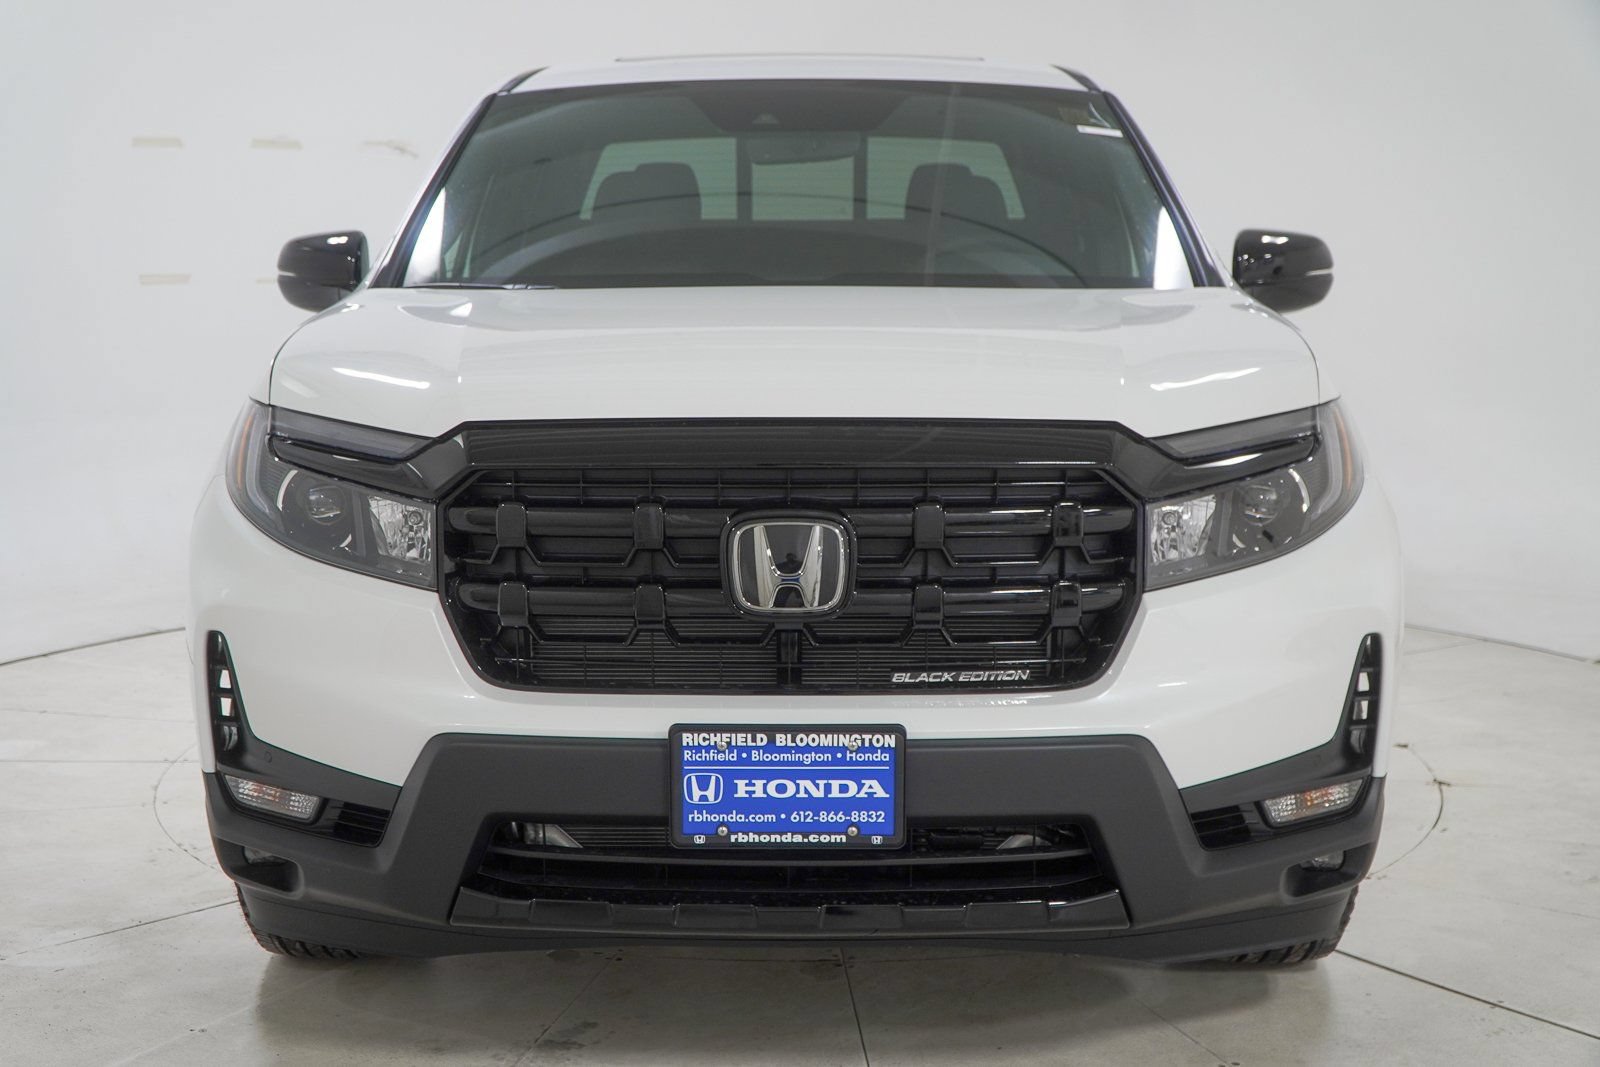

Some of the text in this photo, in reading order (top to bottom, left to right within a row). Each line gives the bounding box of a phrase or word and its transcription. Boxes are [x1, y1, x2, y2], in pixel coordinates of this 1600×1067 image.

[892, 670, 1030, 682] BLACK EDITION
[682, 733, 896, 748] RICHFIELD BLOOMINGTON
[684, 750, 890, 764] Richfield Bloomington Honda
[734, 779, 890, 798] HONDA
[688, 810, 885, 823] rbhonda.com 612-866-8832
[730, 833, 846, 843] rbhonda.com
